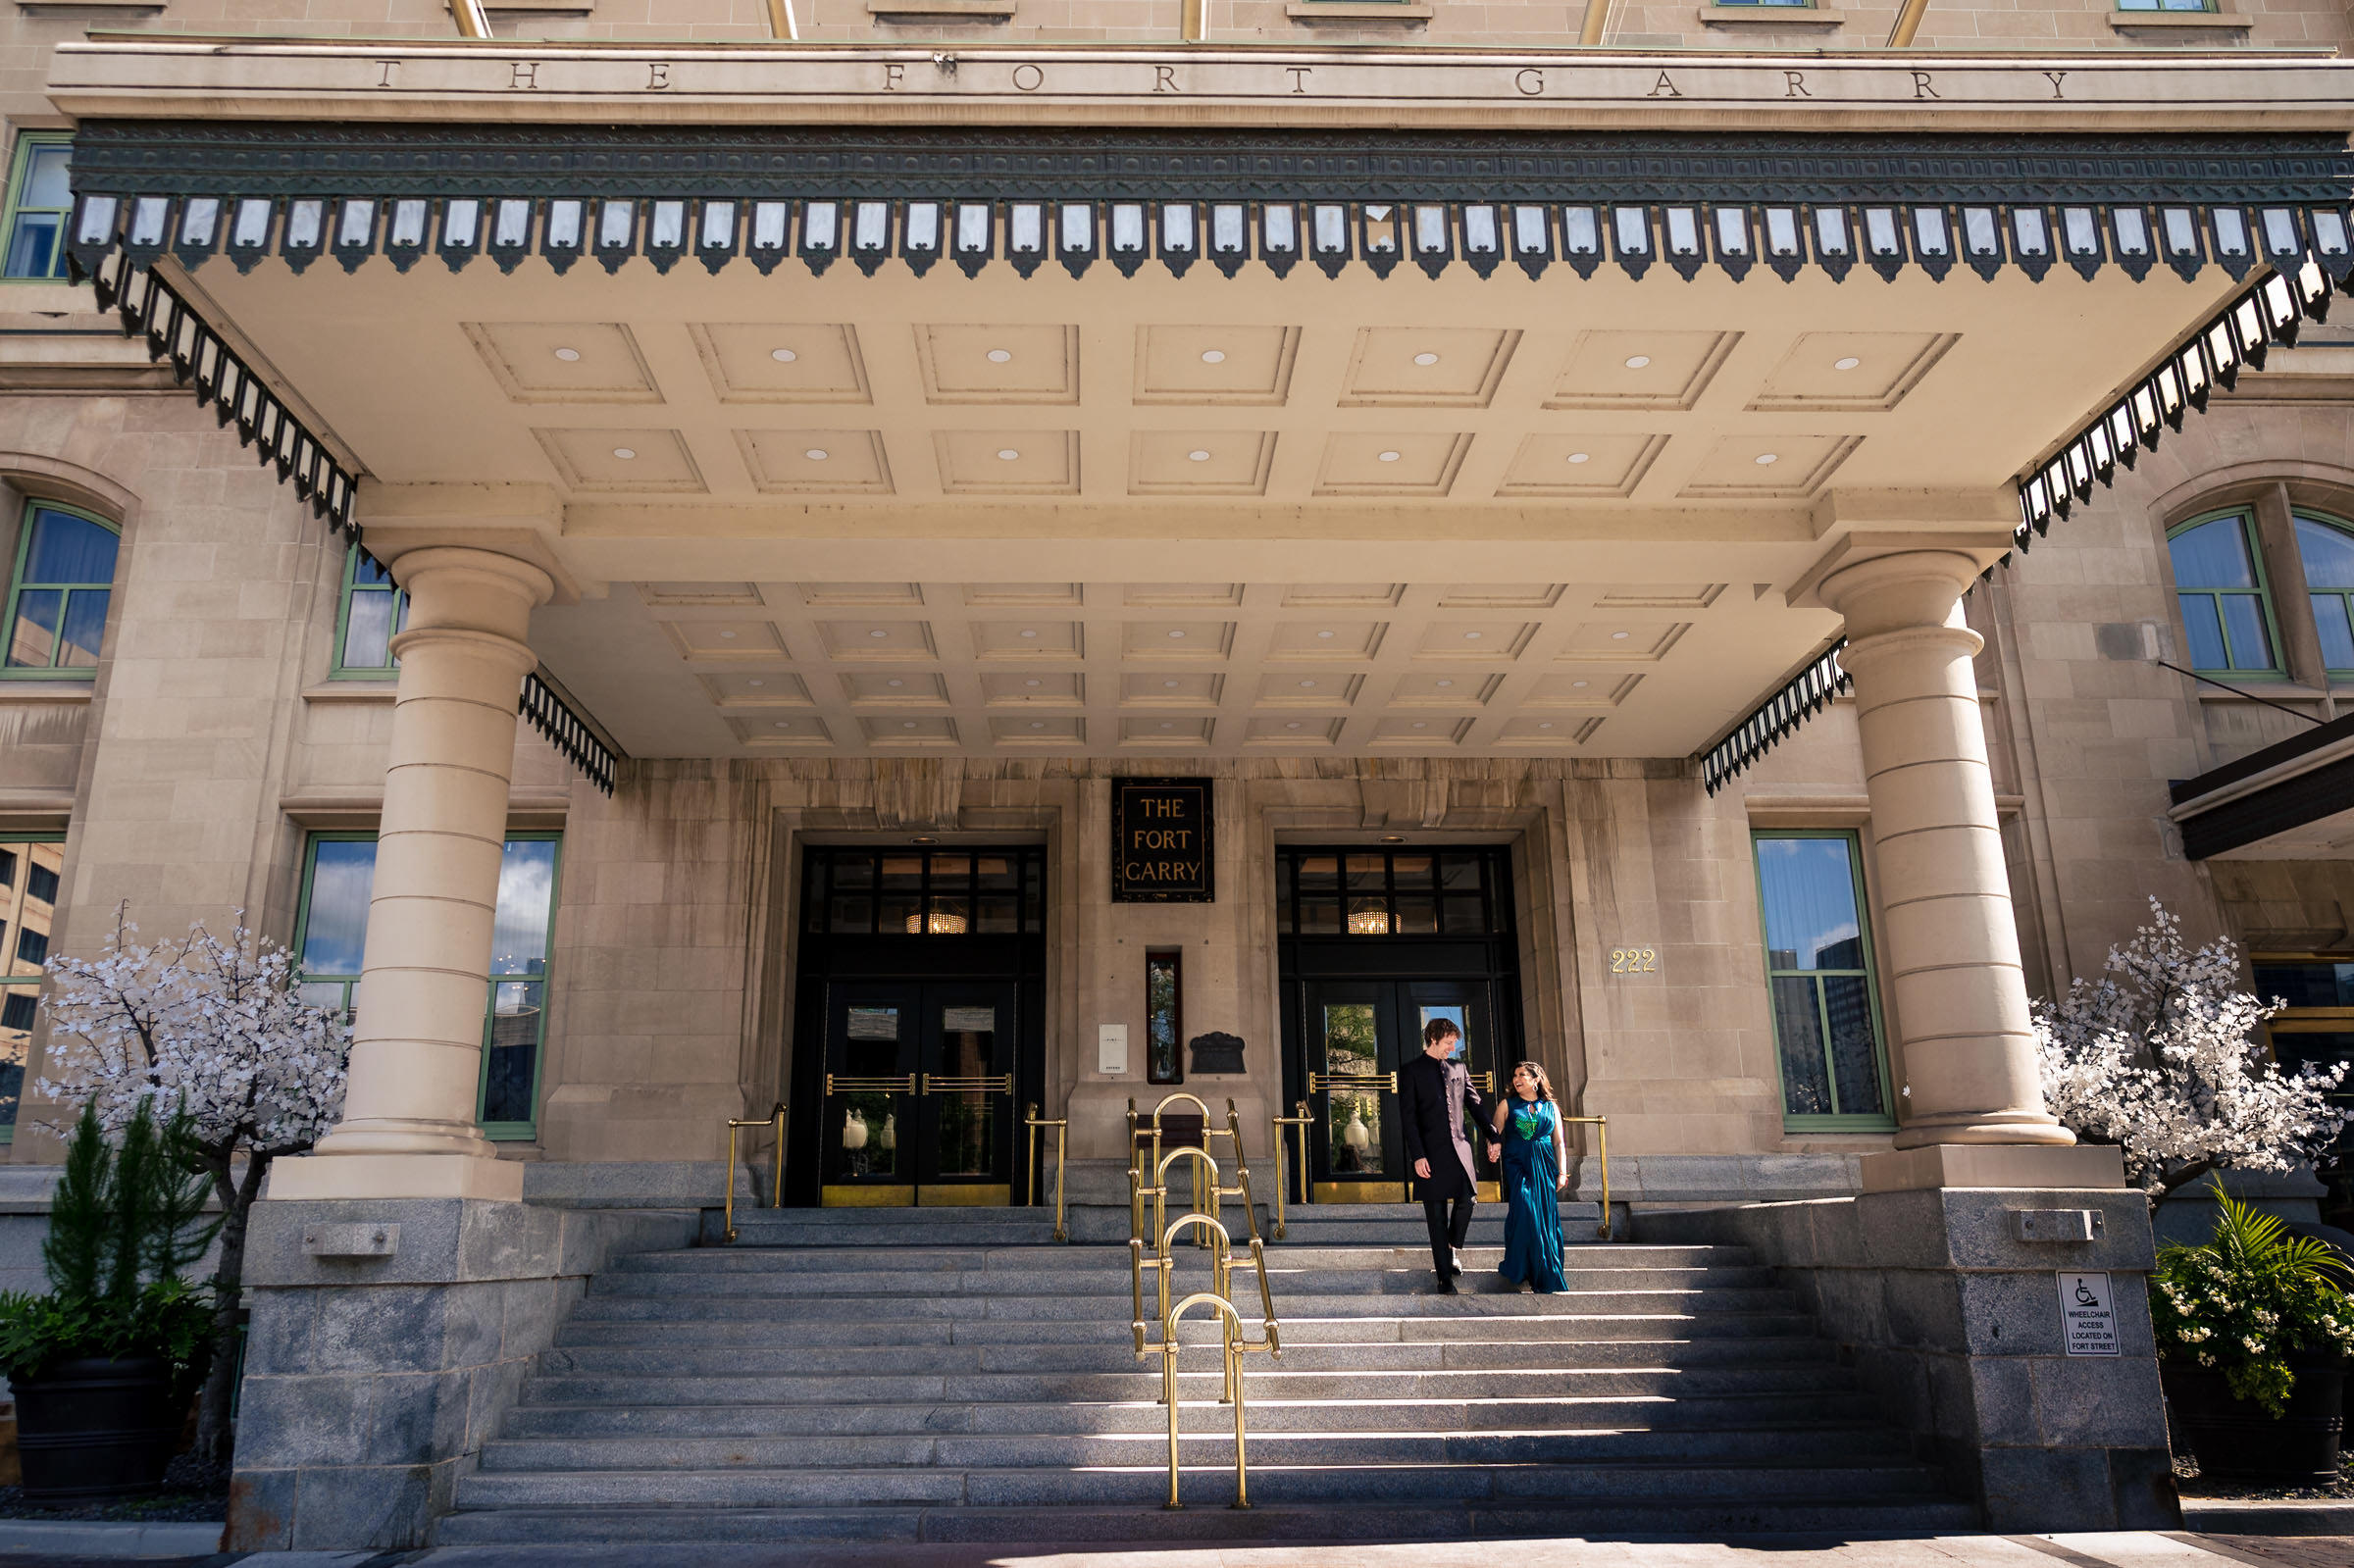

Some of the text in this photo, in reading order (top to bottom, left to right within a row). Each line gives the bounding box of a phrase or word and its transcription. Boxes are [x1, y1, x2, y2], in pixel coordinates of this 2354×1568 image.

[375, 60, 2068, 99] THE FORT GARRY
[1140, 798, 1185, 818] THE
[1133, 830, 1193, 849] FORT
[1612, 949, 1656, 974] 222
[2068, 1310, 2111, 1319] WHEELCHAIR
[2077, 1321, 2105, 1330] ACCESS
[2072, 1332, 2114, 1340] LOCATED ON
